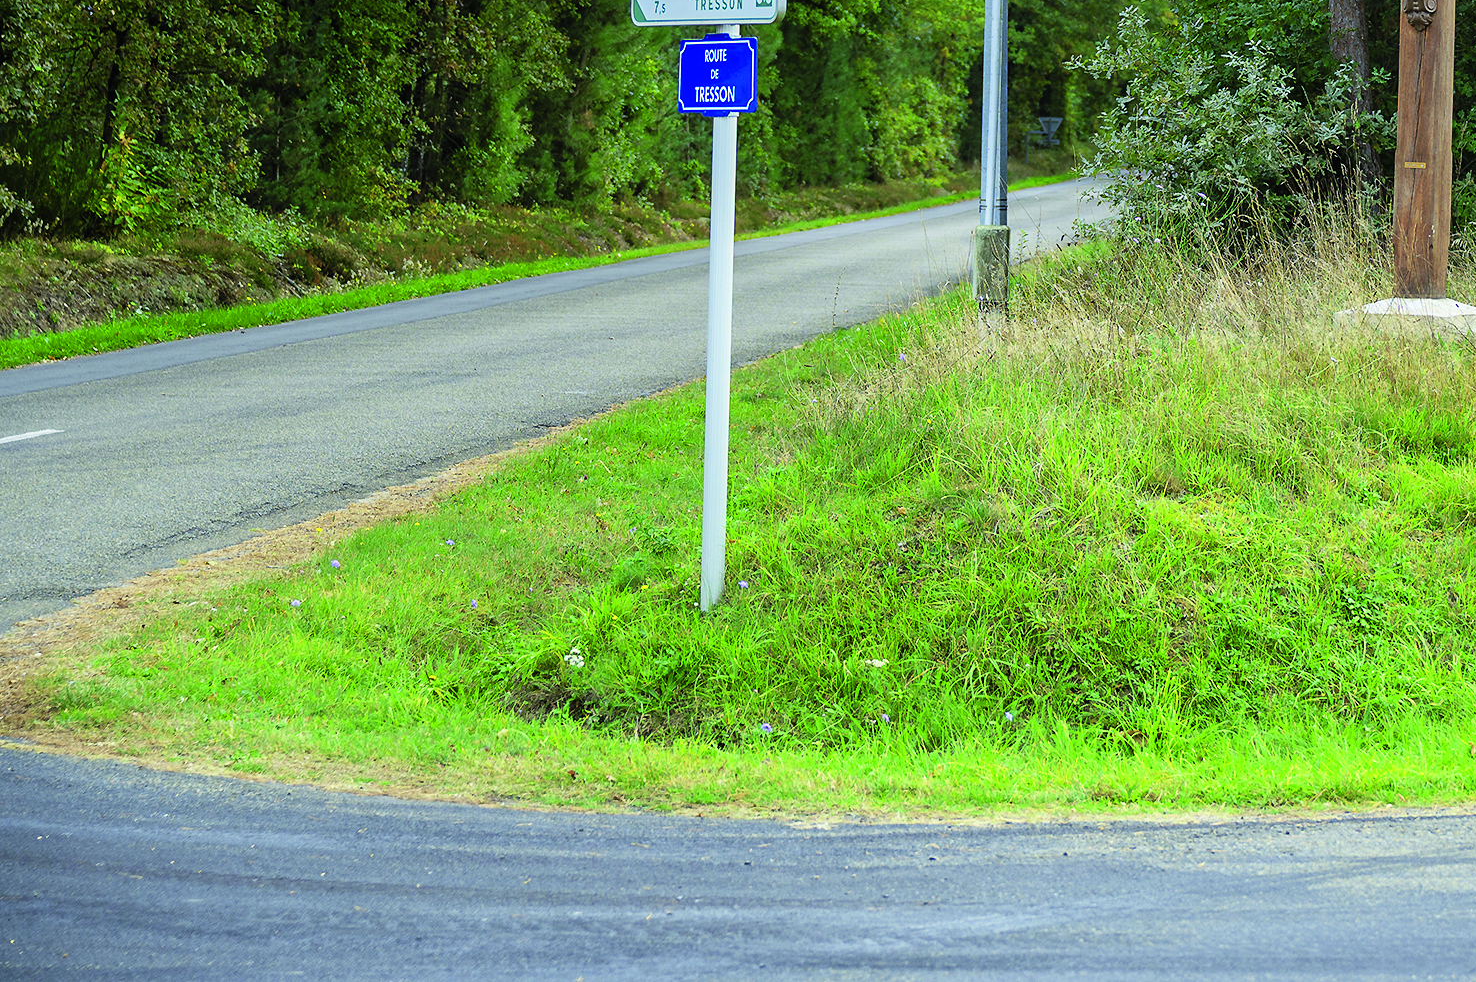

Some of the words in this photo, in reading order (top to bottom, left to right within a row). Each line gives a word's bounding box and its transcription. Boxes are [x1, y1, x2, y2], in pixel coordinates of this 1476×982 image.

[704, 48, 727, 63] ROUTE
[710, 69, 719, 79] DE
[695, 85, 735, 103] TRESSON
